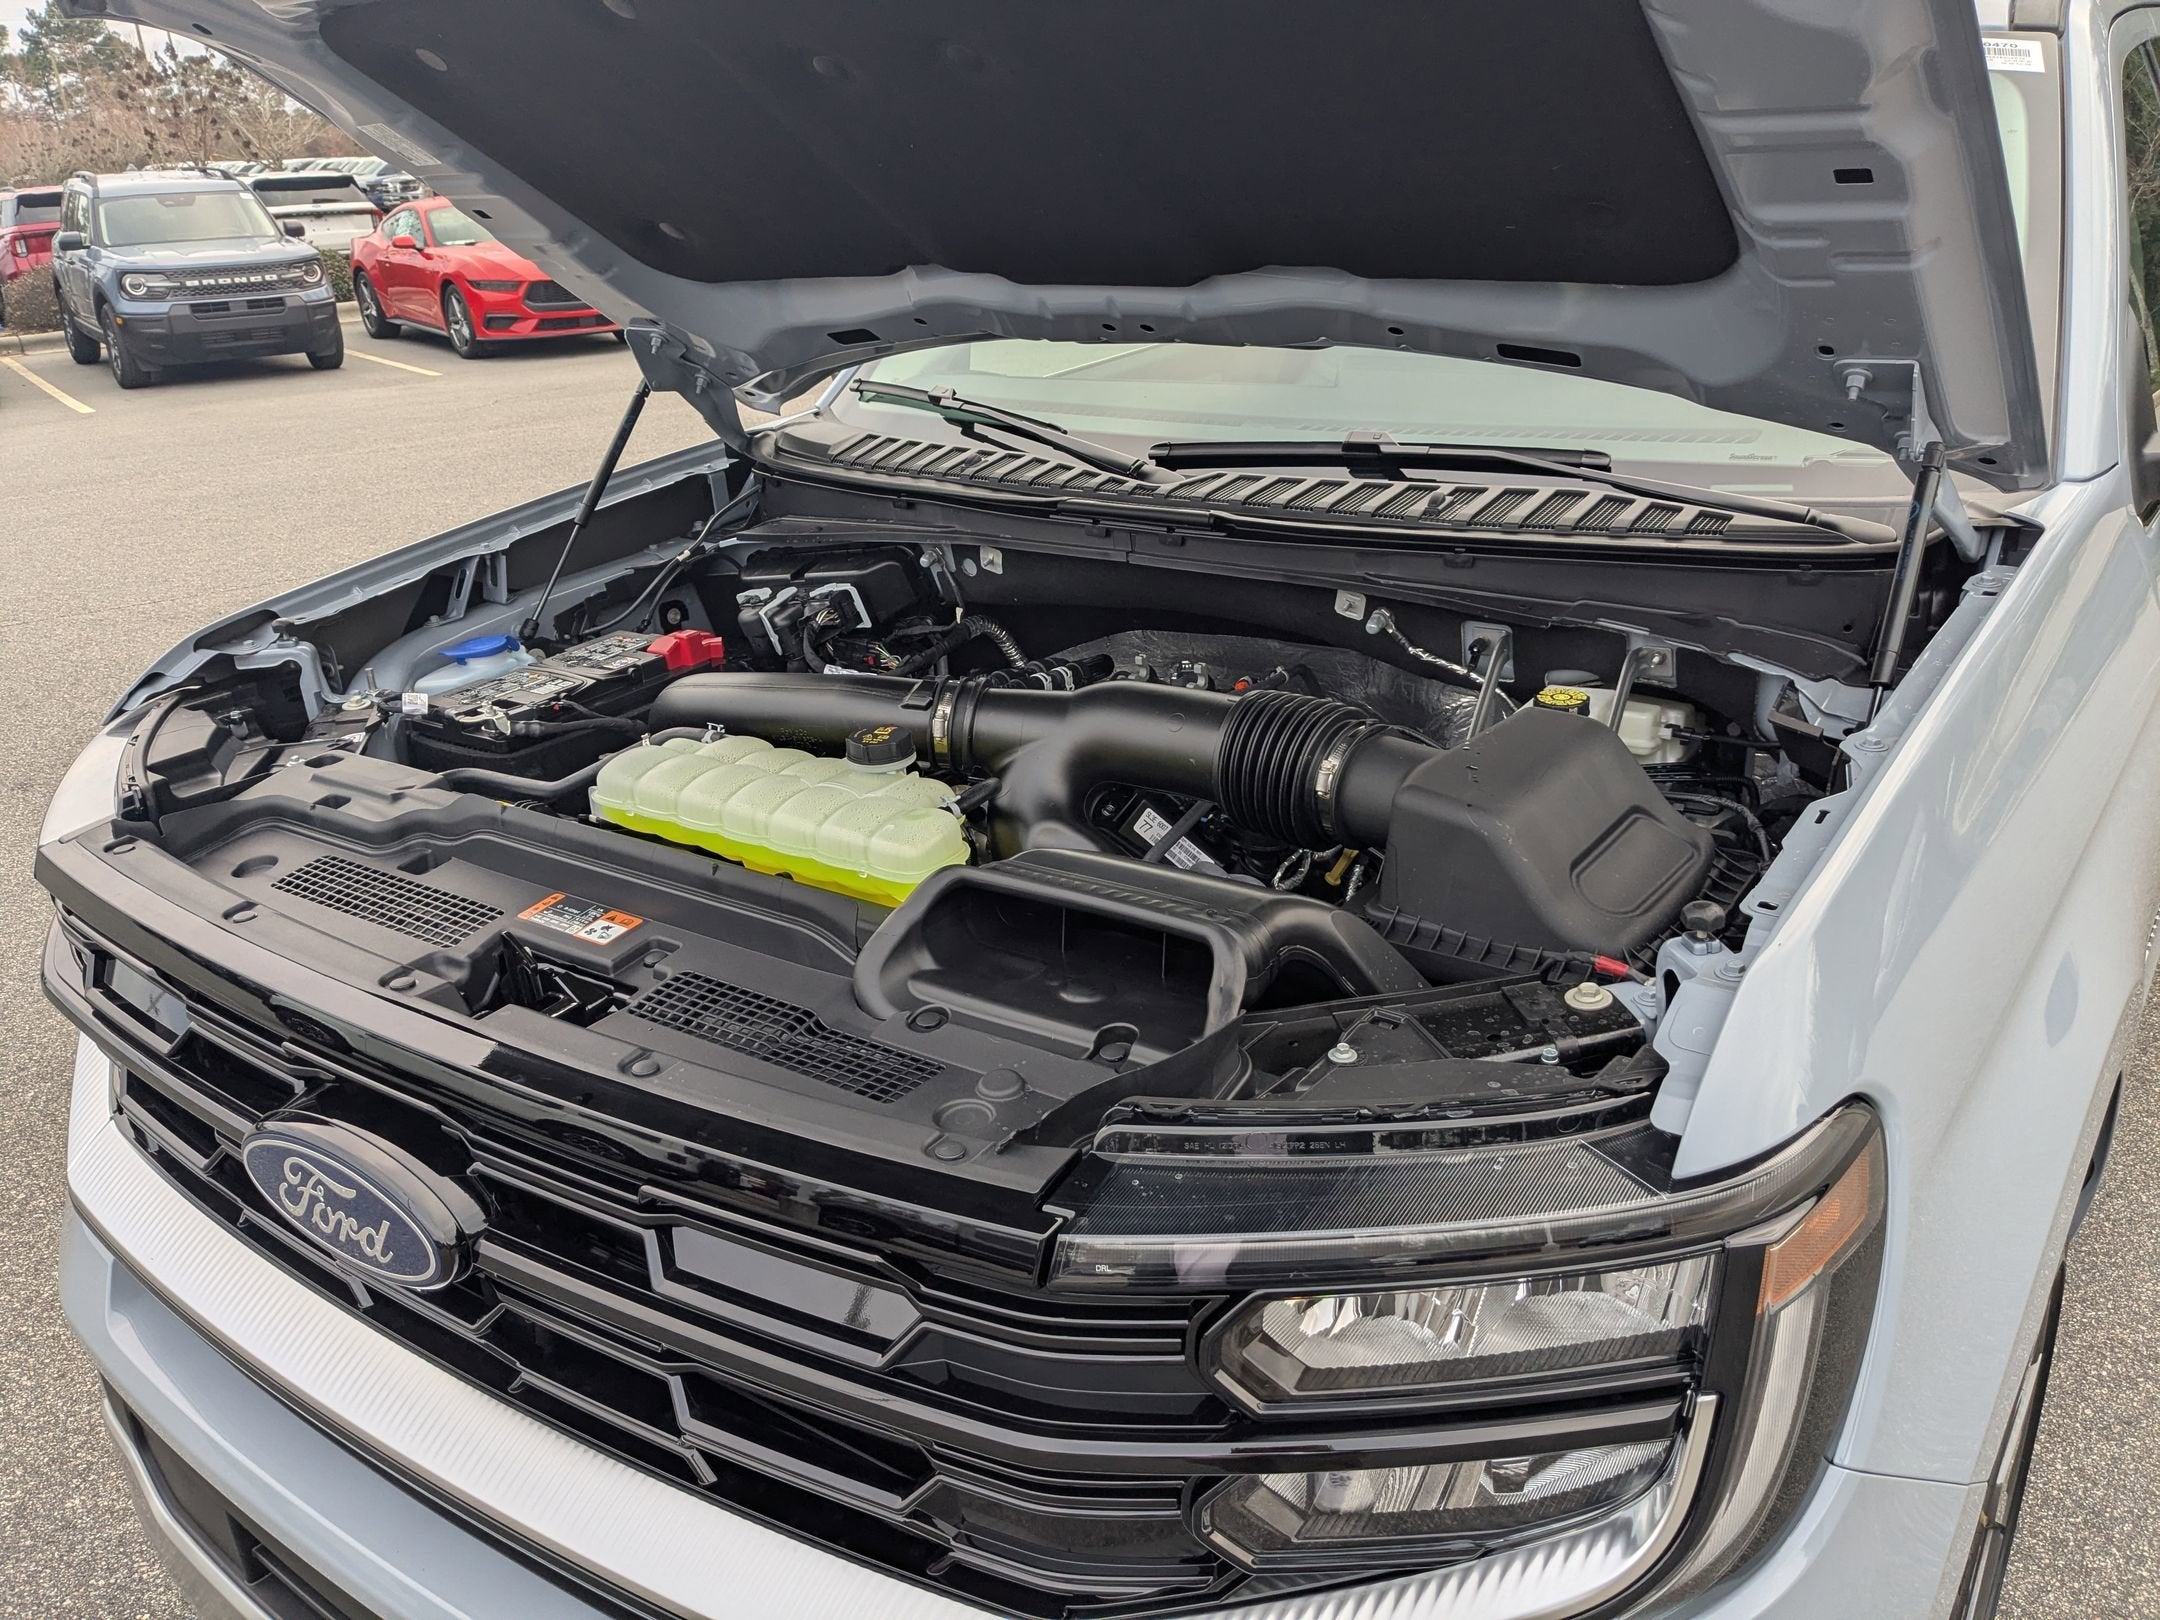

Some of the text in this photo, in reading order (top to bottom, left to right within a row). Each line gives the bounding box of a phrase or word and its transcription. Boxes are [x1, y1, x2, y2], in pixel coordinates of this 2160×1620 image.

[185, 274, 278, 286] BRONCO
[1139, 819, 1153, 833] 77
[1184, 1142, 1200, 1150] SAE
[278, 1156, 394, 1264] Ford
[1095, 1264, 1111, 1272] DRL
